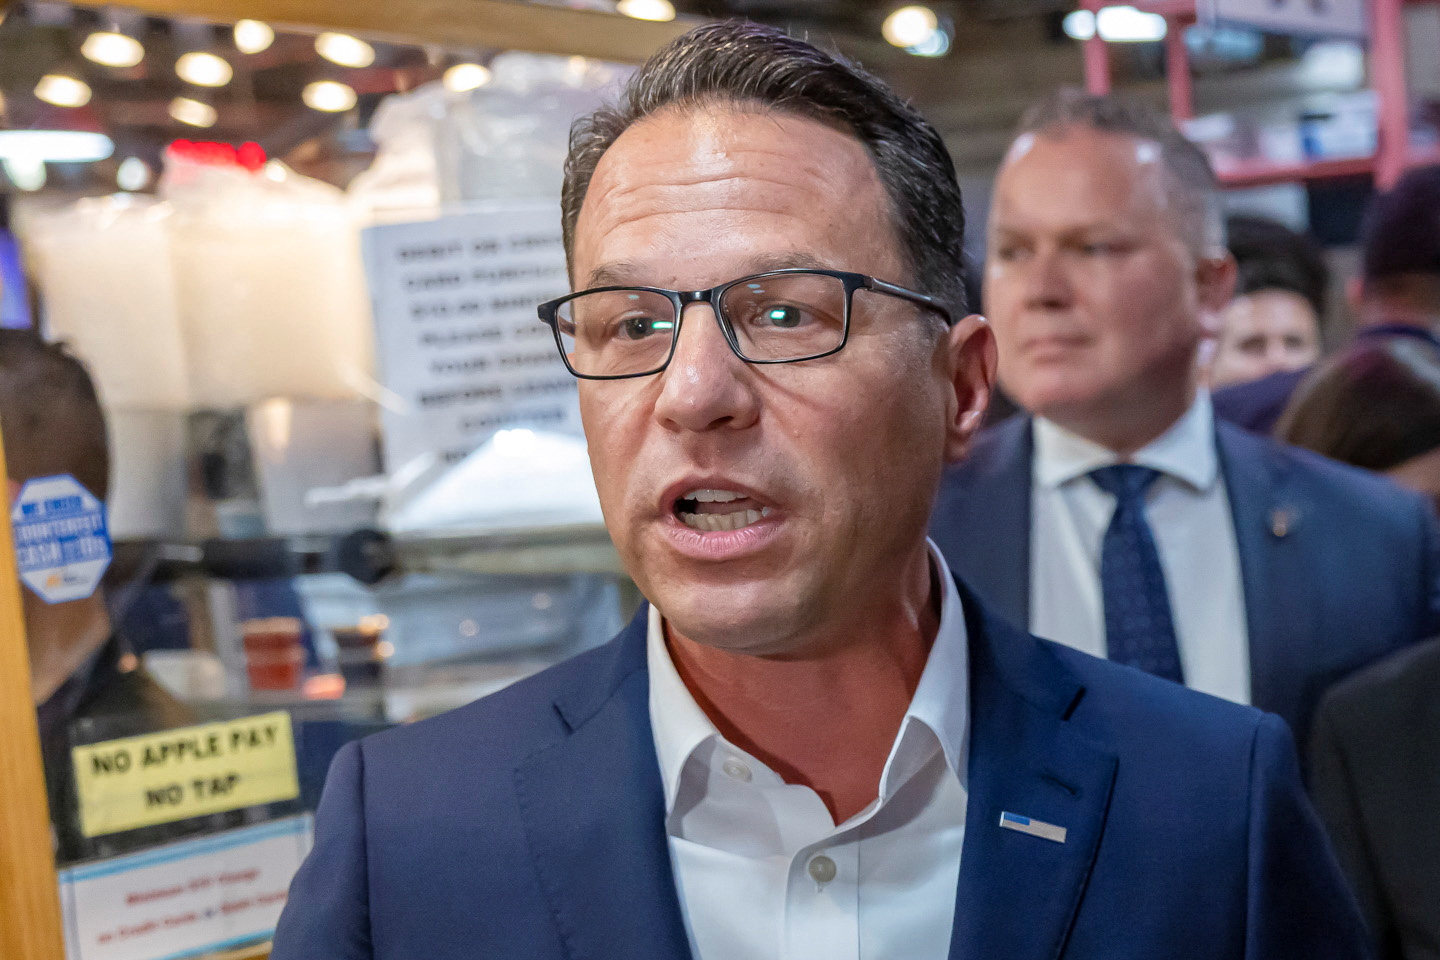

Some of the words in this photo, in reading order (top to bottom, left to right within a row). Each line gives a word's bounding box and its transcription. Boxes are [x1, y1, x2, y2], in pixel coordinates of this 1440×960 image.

[91, 750, 132, 775] NO
[141, 735, 224, 767] APPLE
[229, 726, 278, 750] PAY
[145, 784, 183, 808] NO
[192, 772, 239, 796] TAP
